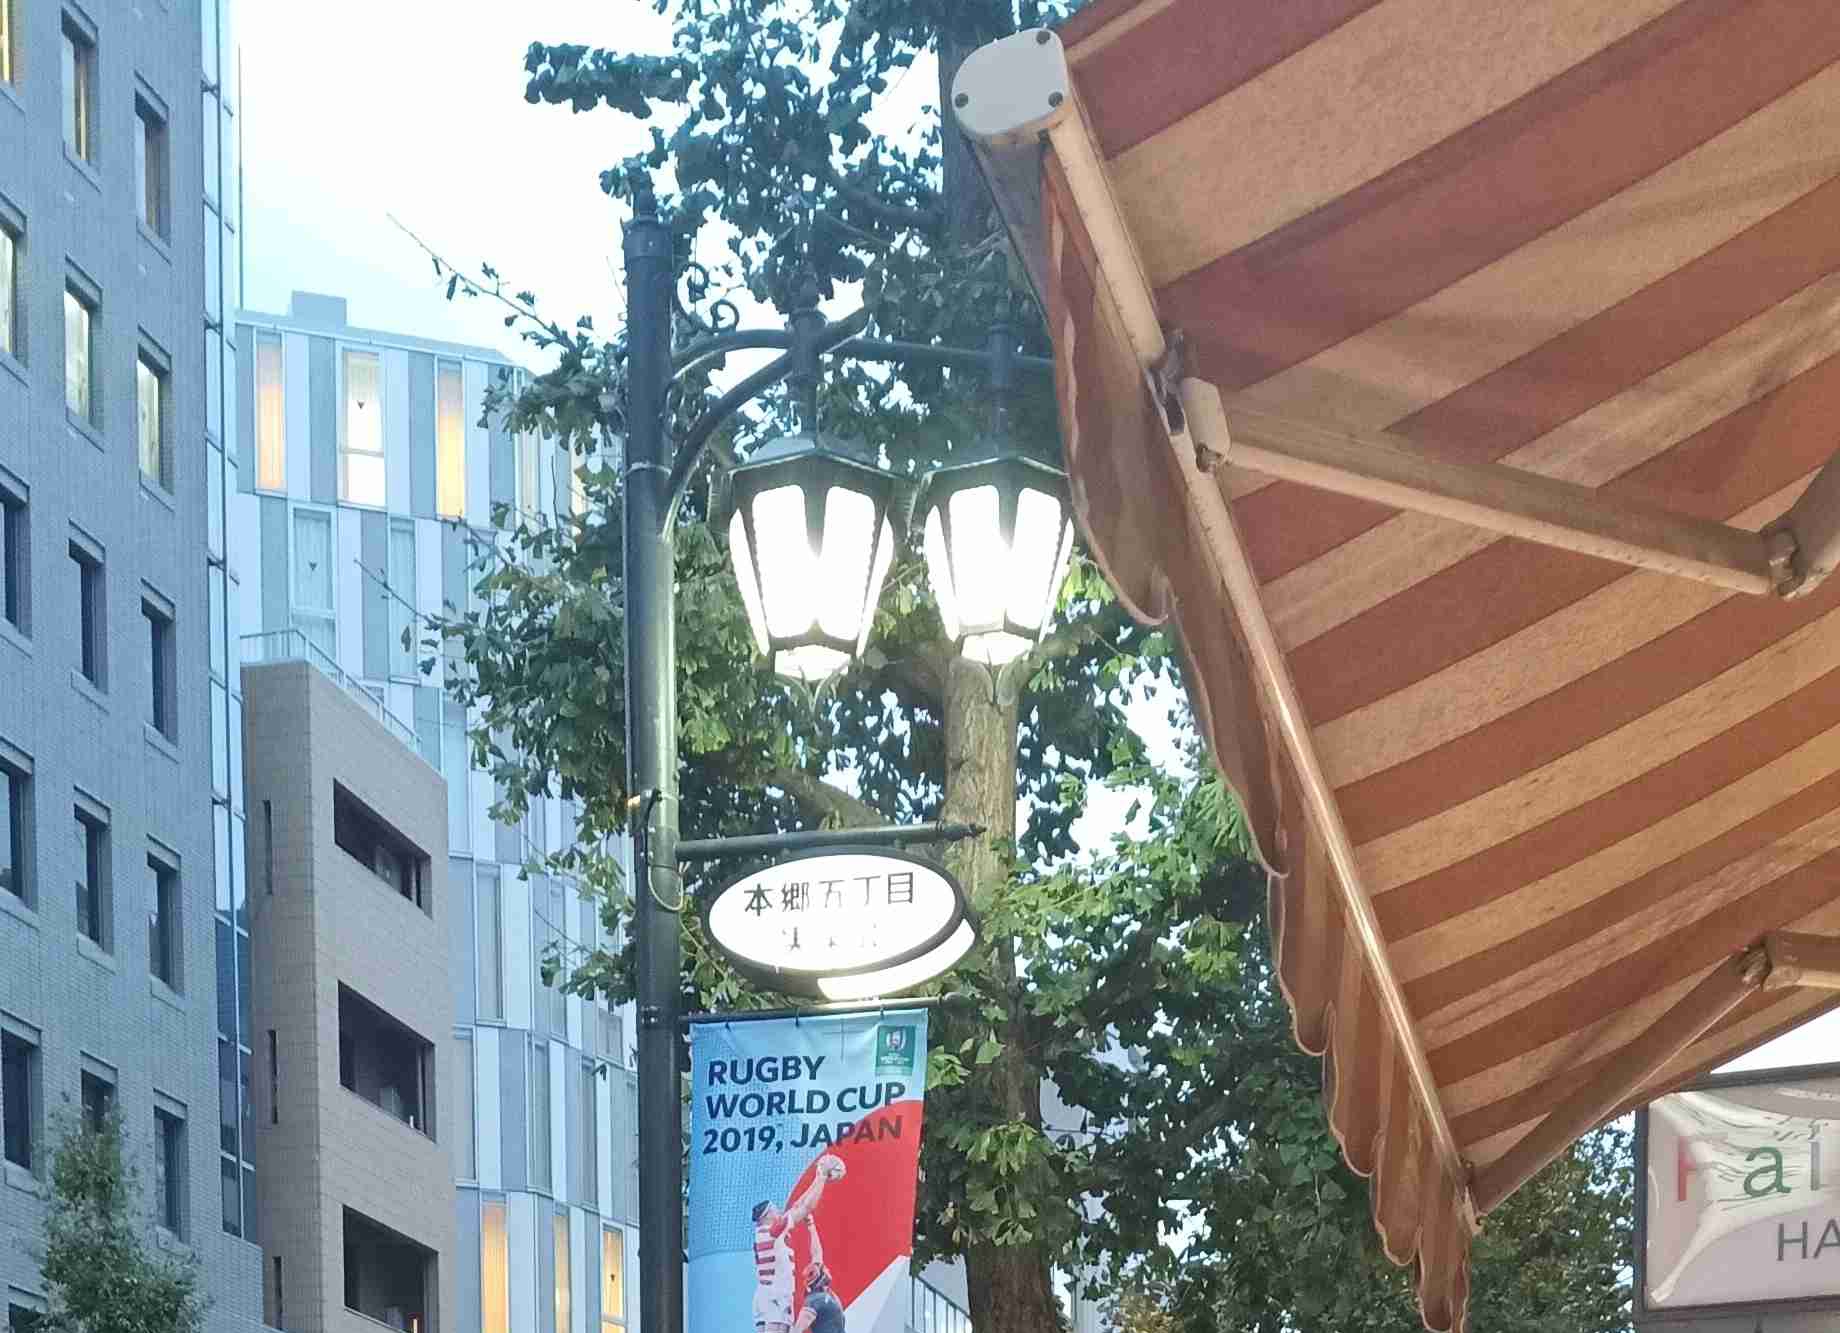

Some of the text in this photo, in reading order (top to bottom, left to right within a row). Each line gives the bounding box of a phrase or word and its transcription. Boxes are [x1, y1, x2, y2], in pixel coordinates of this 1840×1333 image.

[708, 1055, 826, 1086] RUGBY
[706, 1082, 906, 1119] WORLD CUP
[703, 1115, 902, 1154] 2019, JAPAN
